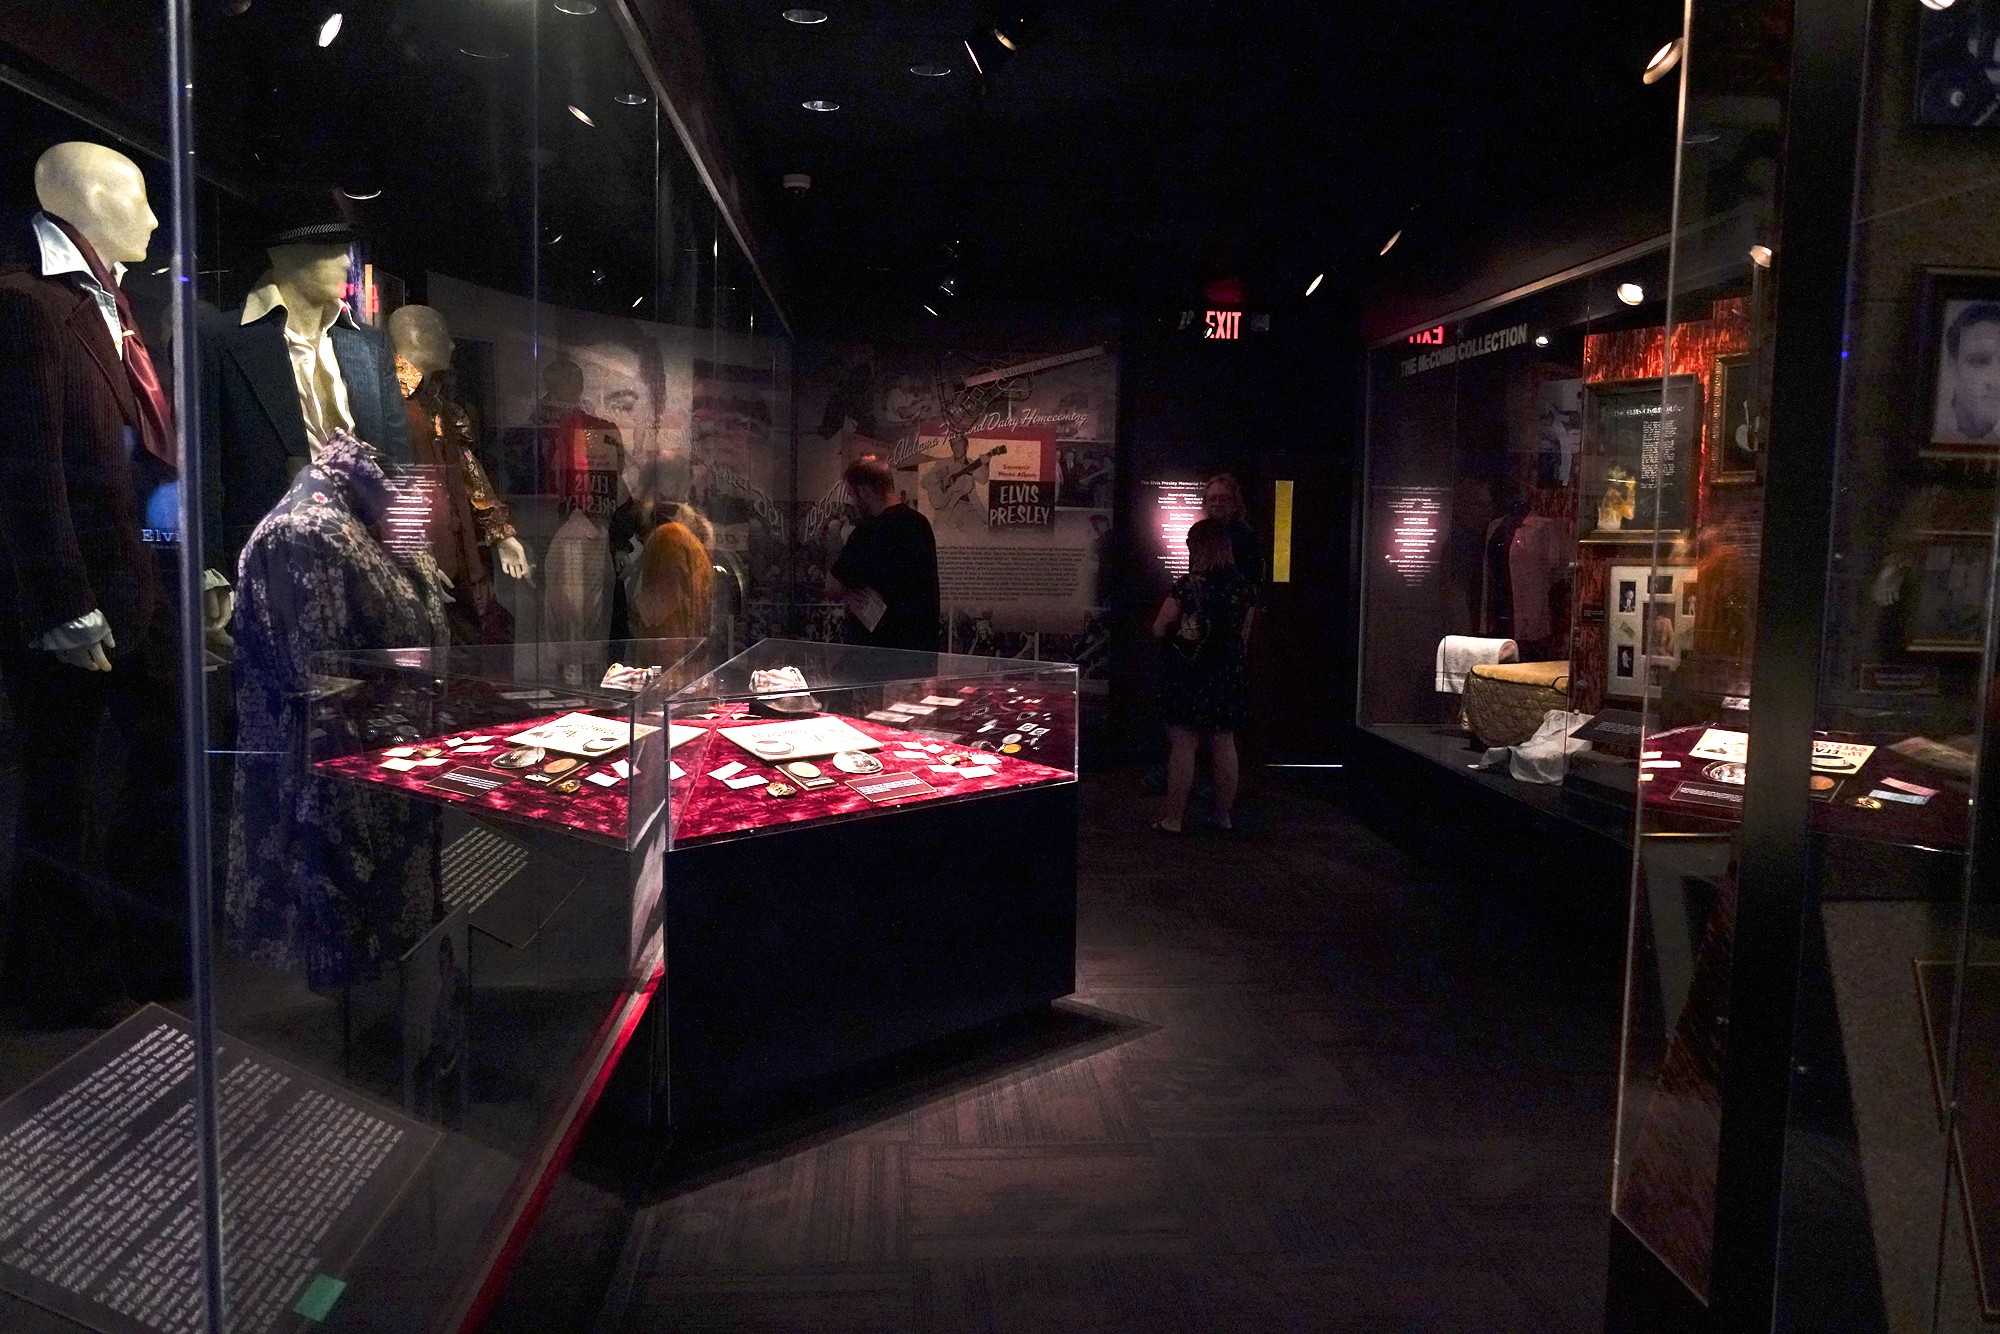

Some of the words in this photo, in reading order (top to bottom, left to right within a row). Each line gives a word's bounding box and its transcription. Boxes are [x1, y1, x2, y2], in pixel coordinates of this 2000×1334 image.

[1205, 310, 1242, 339] EXIT
[1400, 355, 1417, 378] THE
[1418, 345, 1456, 373] McCOMB
[1457, 322, 1528, 361] COLLECTION
[988, 412, 1019, 432] Dairy
[1022, 408, 1088, 426] Homecoming
[999, 483, 1040, 504] ELVIS
[989, 504, 1050, 526] PRESLEY
[141, 528, 182, 542] Elvi
